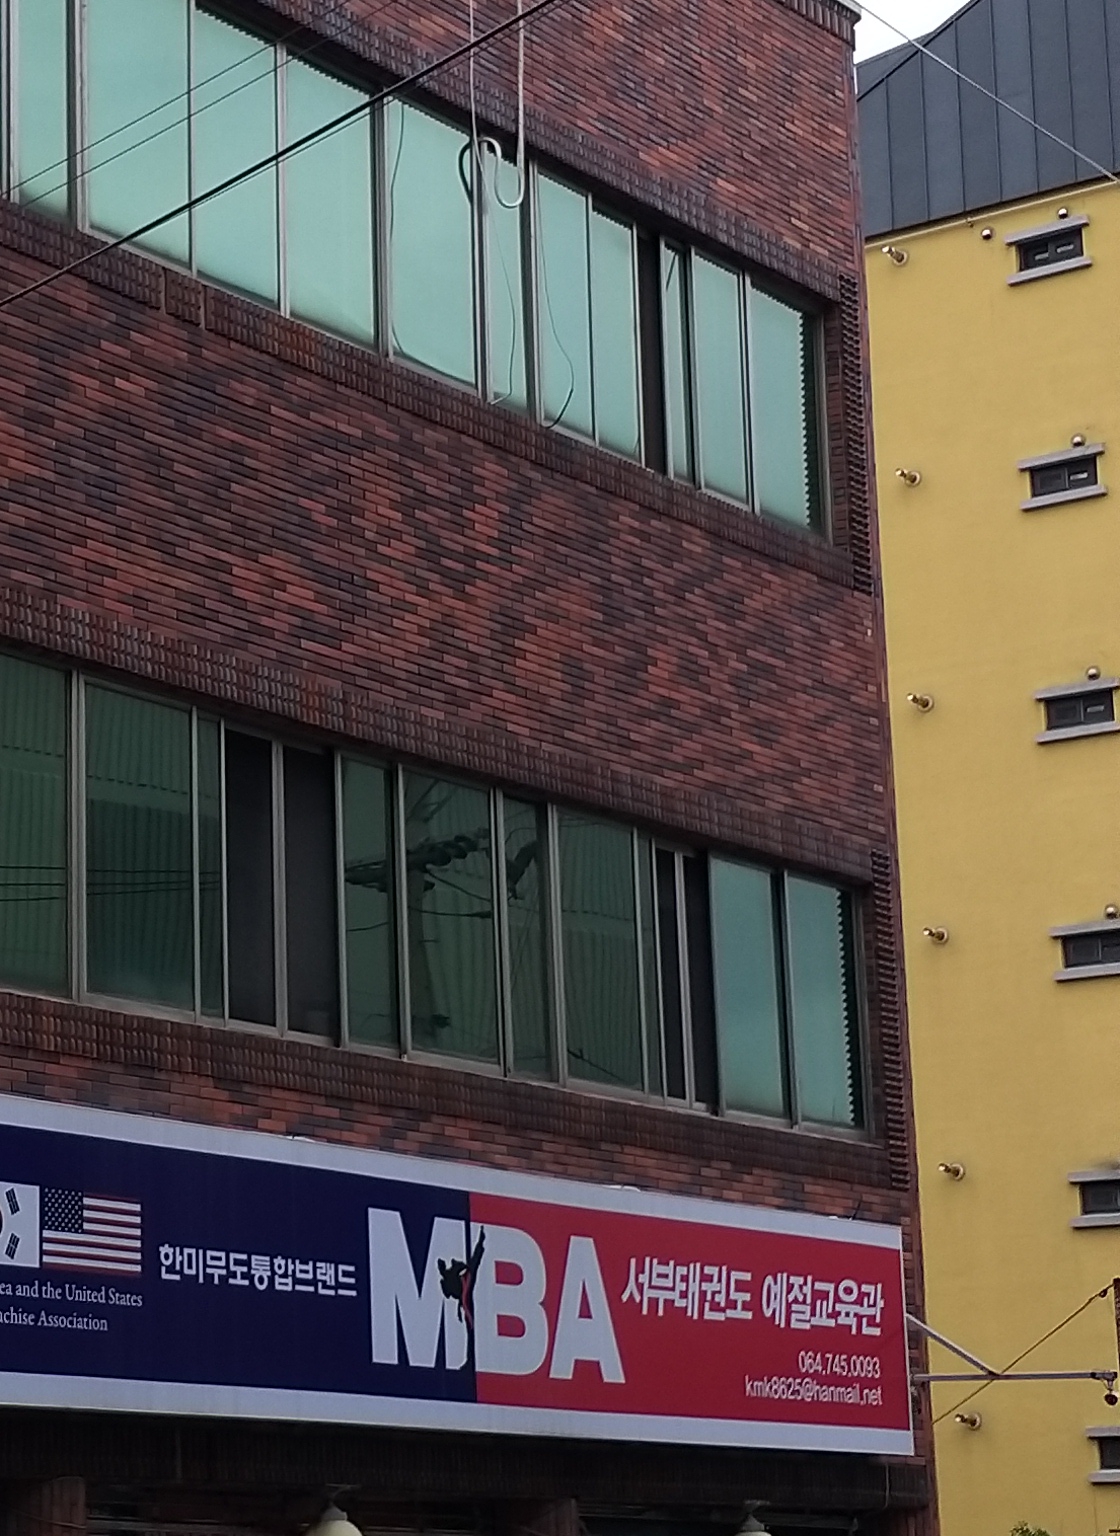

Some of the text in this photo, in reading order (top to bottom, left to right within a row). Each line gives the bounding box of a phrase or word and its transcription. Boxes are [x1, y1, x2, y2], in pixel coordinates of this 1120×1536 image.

[158, 1243, 358, 1297] 한미무도통합브랜드
[15, 1279, 39, 1298] and
[41, 1281, 63, 1301] the
[65, 1283, 106, 1305] United
[108, 1287, 143, 1308] States
[367, 1206, 626, 1384] MBA
[621, 1255, 885, 1337] 서부태권도 예절교육관
[38, 1310, 108, 1332] Association
[798, 1350, 881, 1379] 064.745.0093
[744, 1375, 883, 1407] kmk8625@hanmail.net
